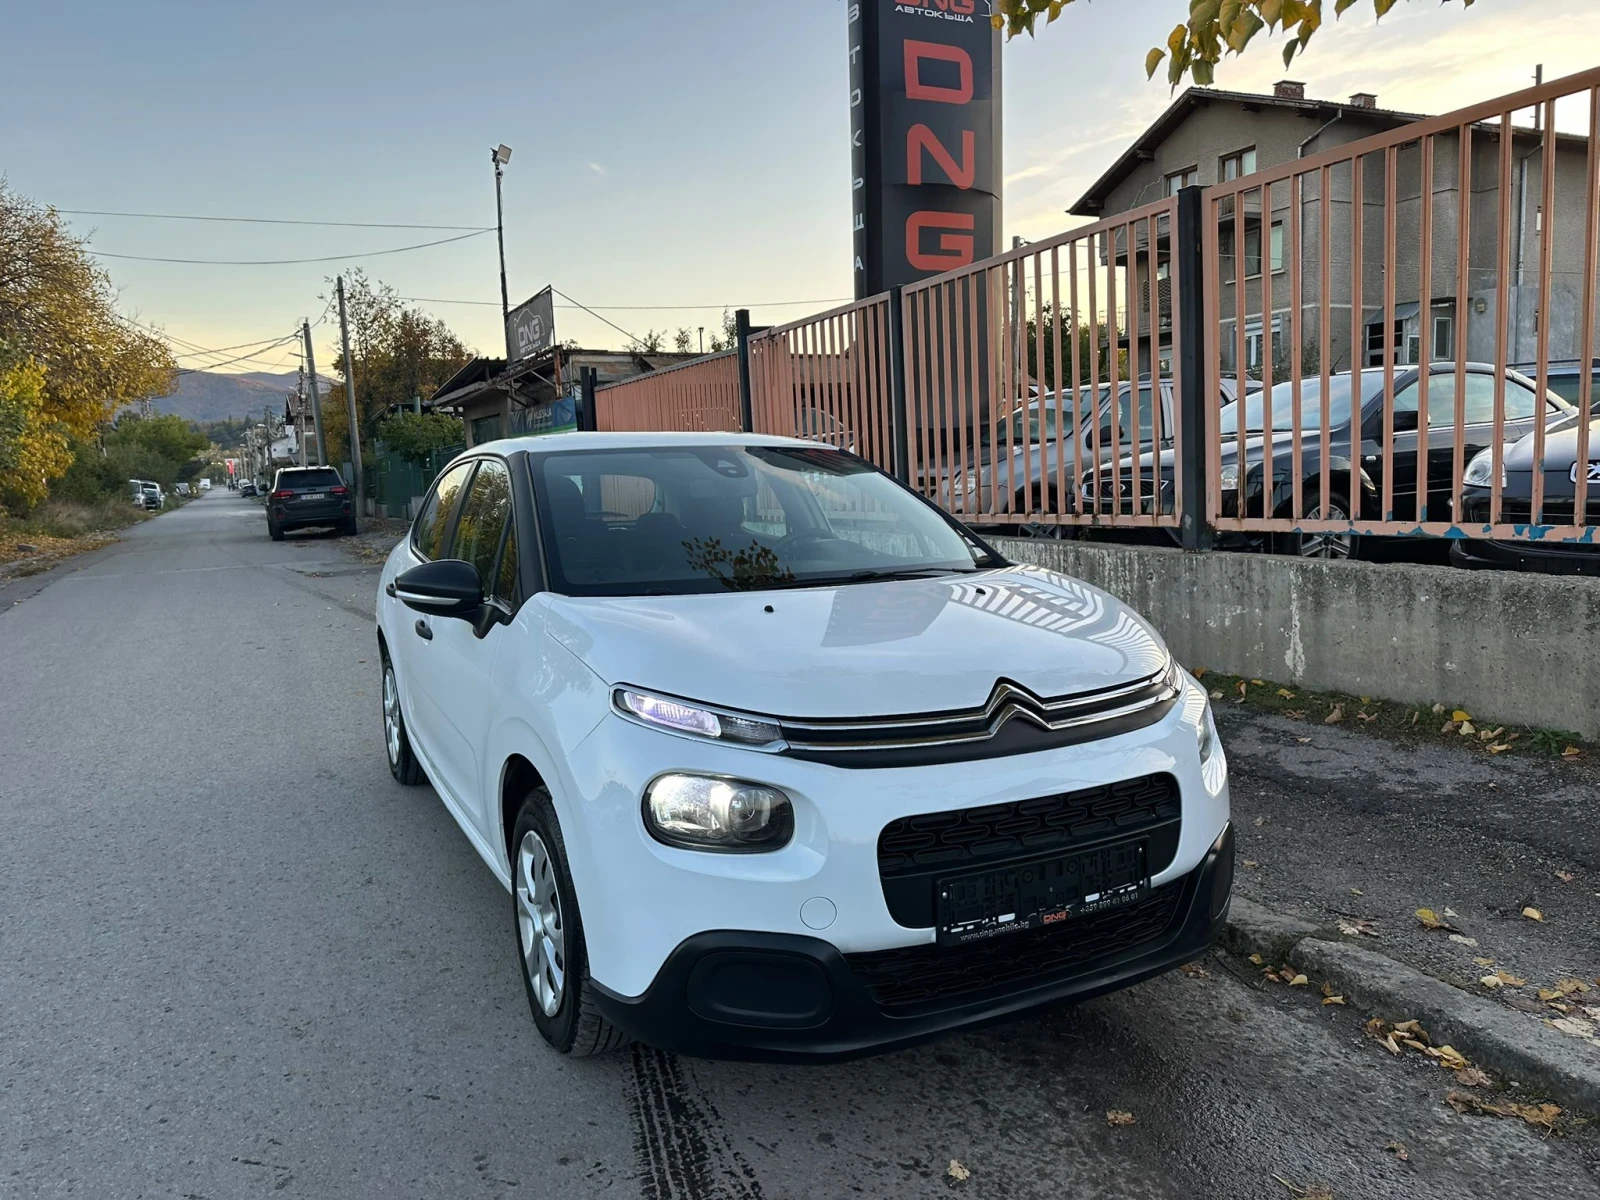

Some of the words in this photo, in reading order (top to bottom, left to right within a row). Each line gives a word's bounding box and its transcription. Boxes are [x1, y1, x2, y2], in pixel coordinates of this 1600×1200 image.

[894, 4, 974, 23] АВТОКЪША
[903, 38, 975, 271] DNG
[517, 318, 540, 347] DNG
[1043, 911, 1067, 923] DNG
[959, 920, 1030, 941] www.dng.mobile.bg
